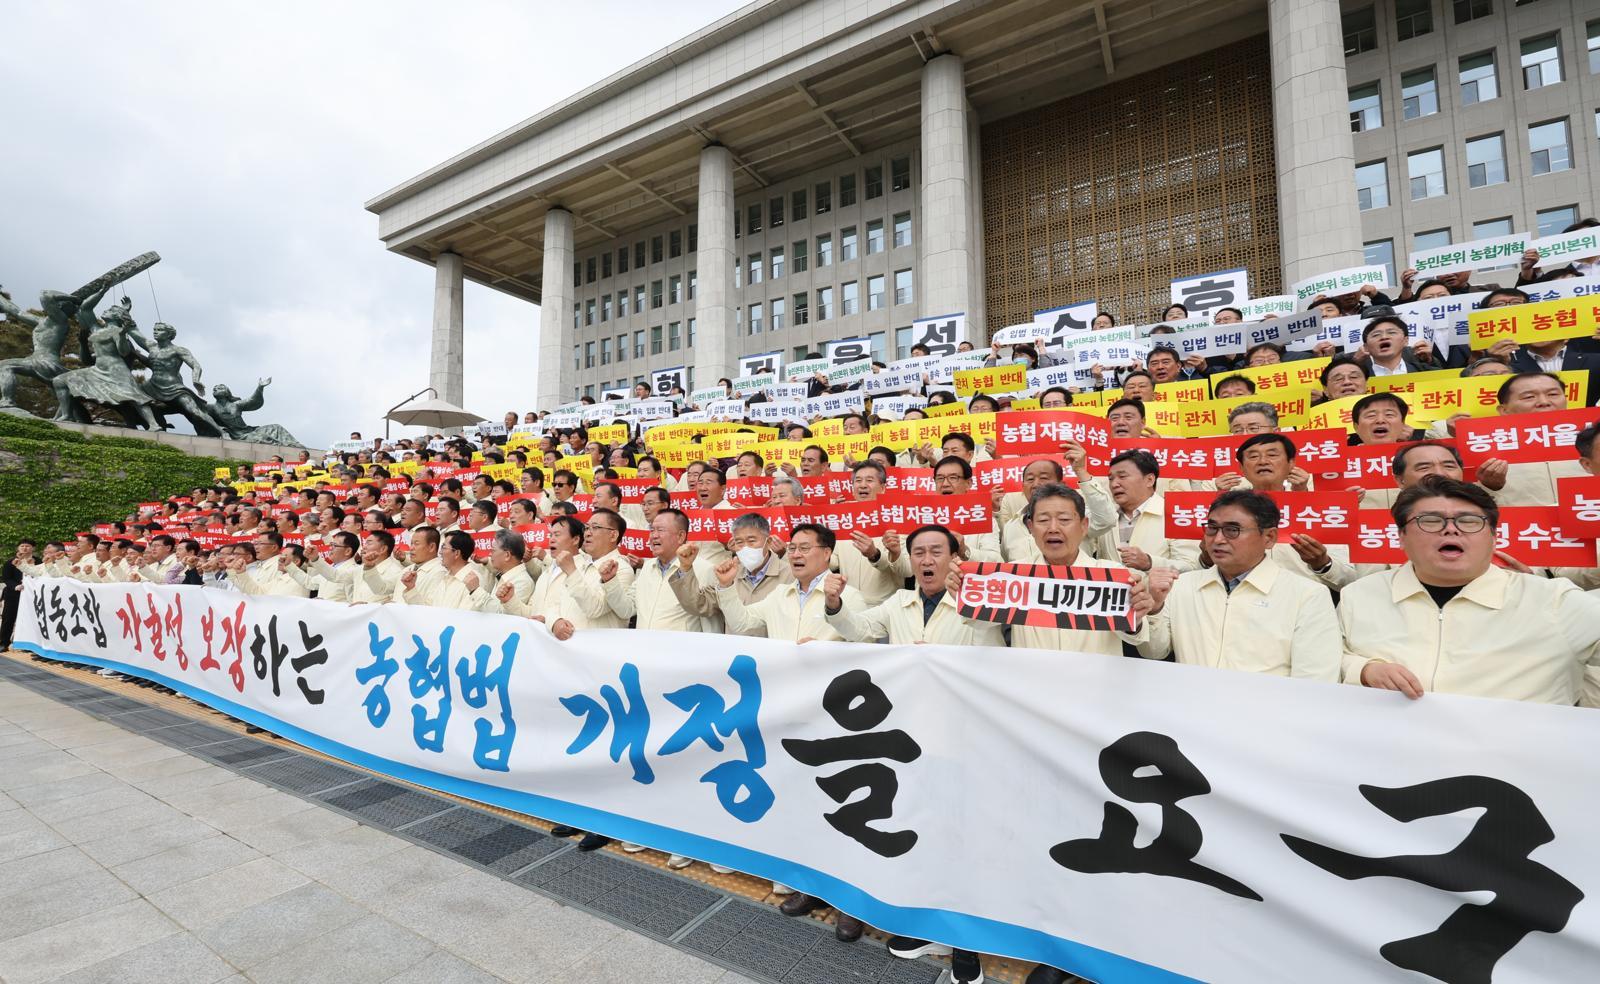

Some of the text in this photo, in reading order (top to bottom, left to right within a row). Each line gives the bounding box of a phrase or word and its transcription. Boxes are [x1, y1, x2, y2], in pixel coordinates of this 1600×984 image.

[1538, 235, 1597, 258] 농민본위
[1415, 241, 1525, 271] 농민본위 농협개혁
[1297, 271, 1383, 299] 농민본위 농협개혁
[1254, 301, 1293, 315] 농협개혁
[1251, 327, 1280, 343] 입법
[1287, 316, 1318, 335] 반대
[1475, 317, 1517, 338] 관치
[1531, 308, 1577, 331] 농협
[1010, 328, 1050, 339] 입법 반대
[1316, 325, 1342, 341] 입법
[1182, 332, 1242, 353] 입법 반대
[1079, 348, 1100, 363] 졸속
[1107, 347, 1129, 359] 입법
[867, 372, 920, 390] 졸속 입법 반대
[973, 375, 993, 388] 농협
[1000, 371, 1022, 385] 반대
[1047, 371, 1068, 385] 입법
[1074, 368, 1093, 381] 반대
[1256, 372, 1288, 390] 농협
[776, 388, 788, 397] 입법
[791, 387, 806, 396] 반대
[1176, 388, 1204, 403] 반대
[1421, 389, 1462, 410] 관치
[658, 406, 671, 414] 반대
[729, 404, 742, 413] 반대
[764, 407, 778, 417] 입법
[781, 407, 796, 416] 반대
[807, 396, 861, 414] 졸속 입법 반대
[1184, 399, 1305, 427] 관치 반대
[611, 430, 625, 439] 반대
[652, 430, 683, 441] 농협 반대
[758, 433, 776, 442] 반대
[823, 425, 839, 436] 농협
[889, 428, 909, 441] 농협
[920, 425, 941, 439] 관치
[1002, 421, 1108, 448] 농협 자율성 수호
[1466, 421, 1592, 453] 농협 자율
[716, 440, 731, 451] 농협
[827, 441, 868, 455] 농협 반대
[1299, 440, 1340, 462] 수호
[669, 450, 682, 461] 농협
[686, 450, 704, 460] 반대
[765, 448, 783, 461] 농협
[1171, 449, 1208, 468] 수호
[1214, 447, 1231, 466] 협
[574, 459, 590, 470] 반대
[886, 476, 898, 489] 호
[980, 468, 1003, 486] 농협
[753, 484, 770, 497] 농협
[803, 484, 826, 498] 수호
[681, 498, 700, 510] 수호
[814, 512, 853, 530] 자율성
[881, 504, 987, 525] 농협 자율성 수호
[1172, 505, 1210, 527] 농협
[1296, 506, 1348, 529] 수호
[965, 577, 1128, 612] 농협이 니끼가!!
[33, 584, 1585, 984] 협동조합 자율성 보장하는 농협법 개정을 요구
